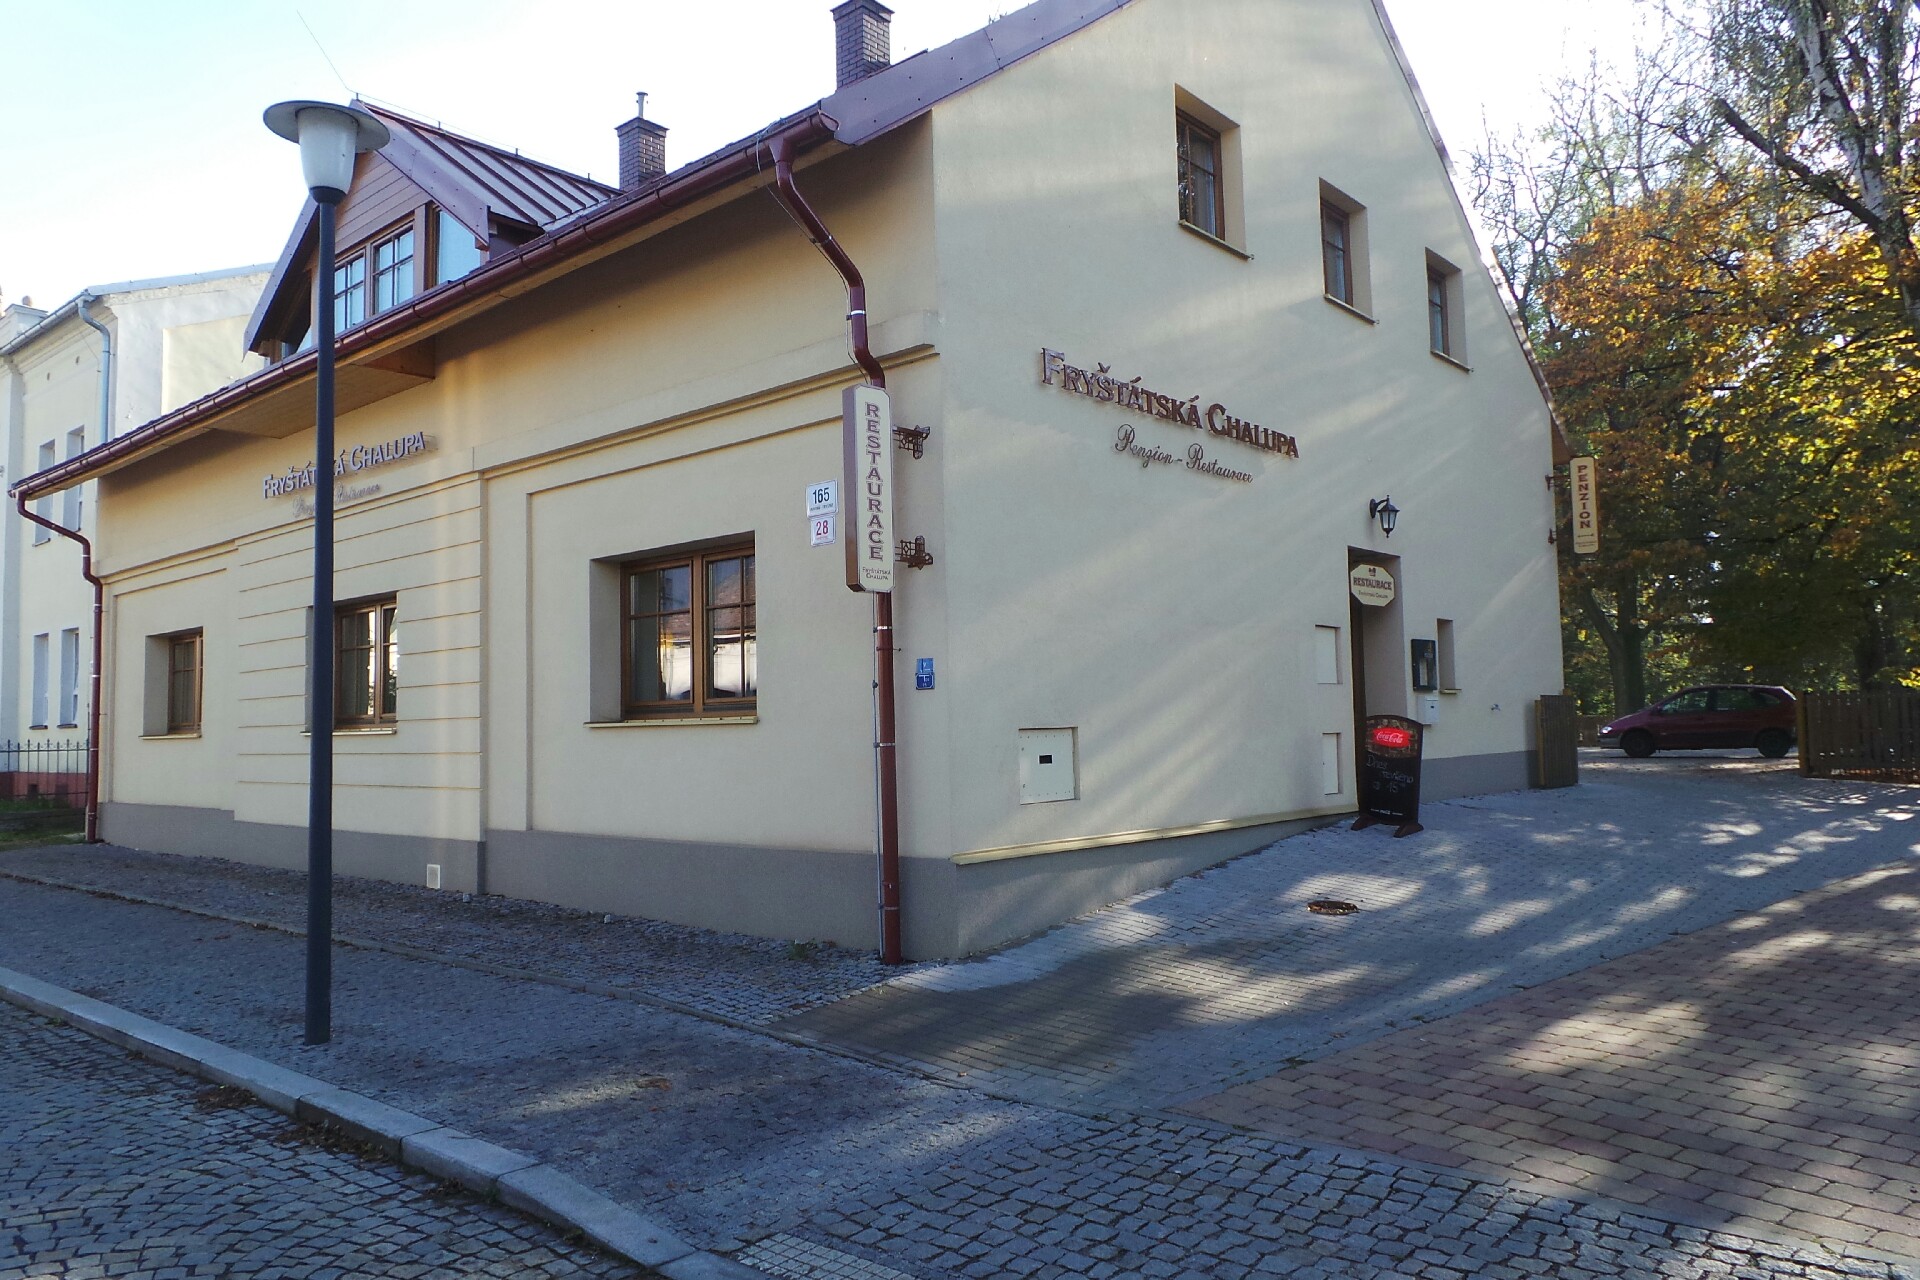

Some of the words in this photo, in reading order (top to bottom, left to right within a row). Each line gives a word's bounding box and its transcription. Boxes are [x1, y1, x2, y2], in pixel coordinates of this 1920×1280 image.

[1041, 347, 1202, 430] FRYŠTÁTSKÁ
[1206, 403, 1299, 459] CHALUPA
[262, 449, 346, 499] FRYŠTÁTÁ
[351, 431, 426, 471] CHALUPA
[865, 401, 884, 562] RESTAURACE
[1114, 423, 1174, 468] Penzion
[1186, 442, 1254, 484] Restaurace
[812, 487, 830, 505] 165
[816, 519, 829, 536] 28
[1577, 464, 1592, 529] PENZION
[1353, 576, 1393, 591] RESTAURACE
